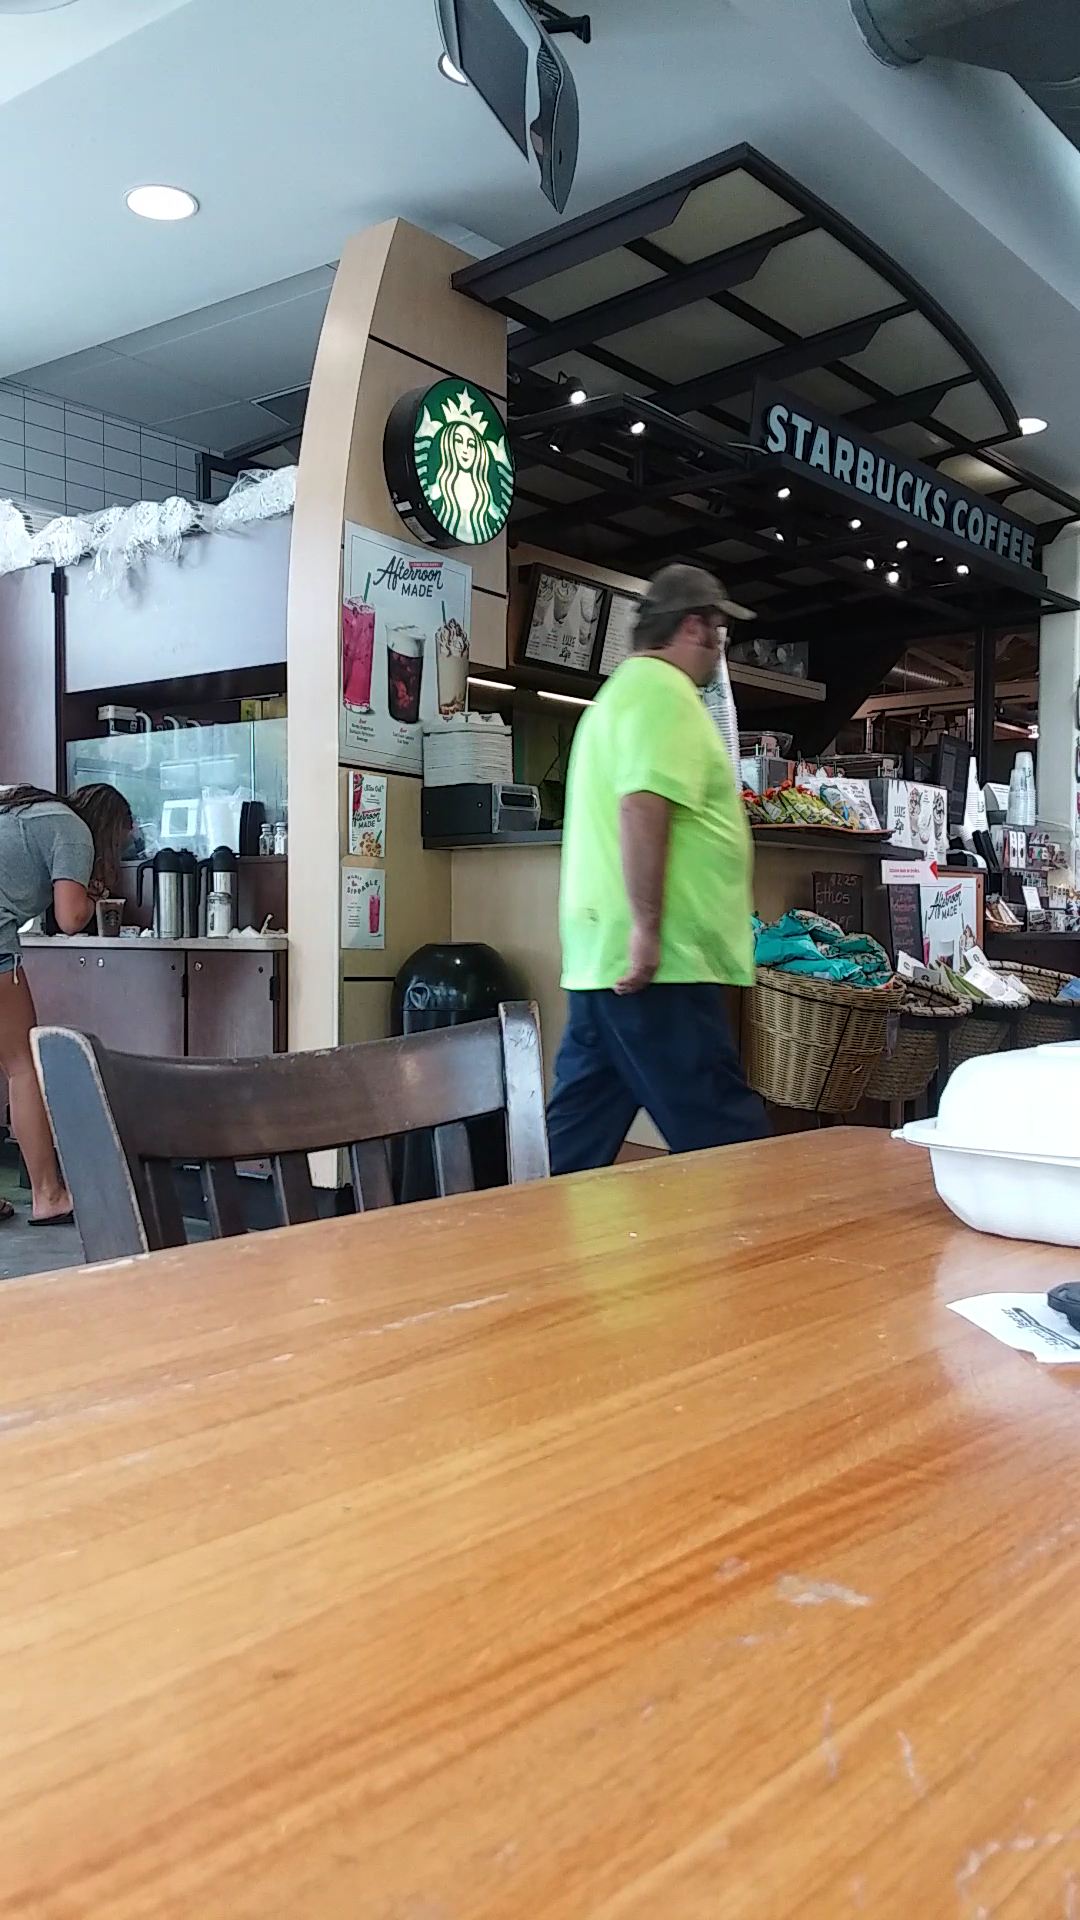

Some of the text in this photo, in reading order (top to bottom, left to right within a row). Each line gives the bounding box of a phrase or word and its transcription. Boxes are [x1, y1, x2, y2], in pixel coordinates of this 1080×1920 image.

[766, 404, 1036, 569] STARBUCKS COFFEE
[373, 555, 444, 591] Afternoon
[401, 583, 434, 597] MADE
[358, 820, 376, 828] MADE
[346, 879, 379, 895] SIPPABLE
[815, 882, 851, 905] Ethos
[927, 891, 963, 921] Afternoon
[941, 904, 958, 920] MADE
